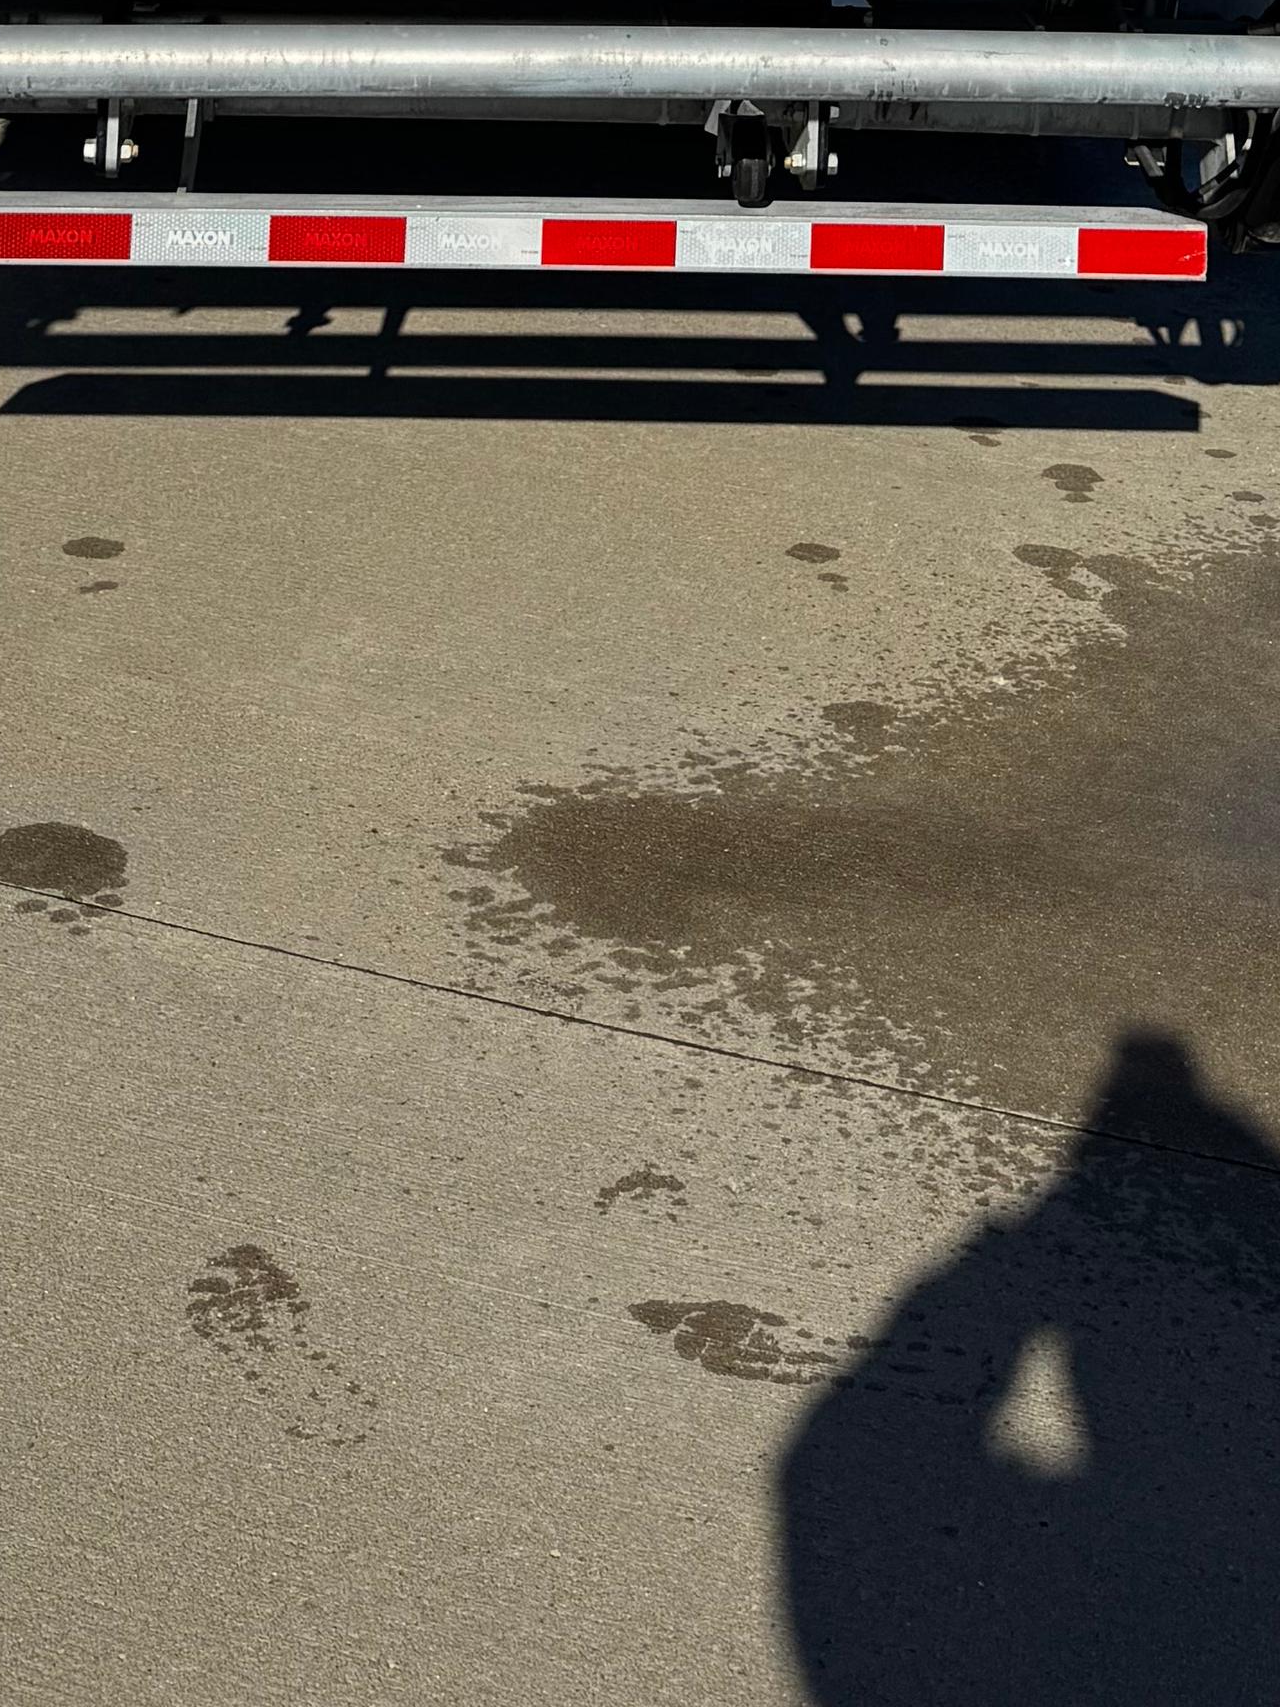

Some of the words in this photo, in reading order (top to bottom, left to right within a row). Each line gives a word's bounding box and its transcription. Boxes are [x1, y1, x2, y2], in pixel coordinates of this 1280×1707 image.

[30, 228, 93, 244] MAXON
[167, 230, 232, 246] MAXON
[440, 233, 503, 250] MAXON
[978, 242, 1039, 258] MAXON
